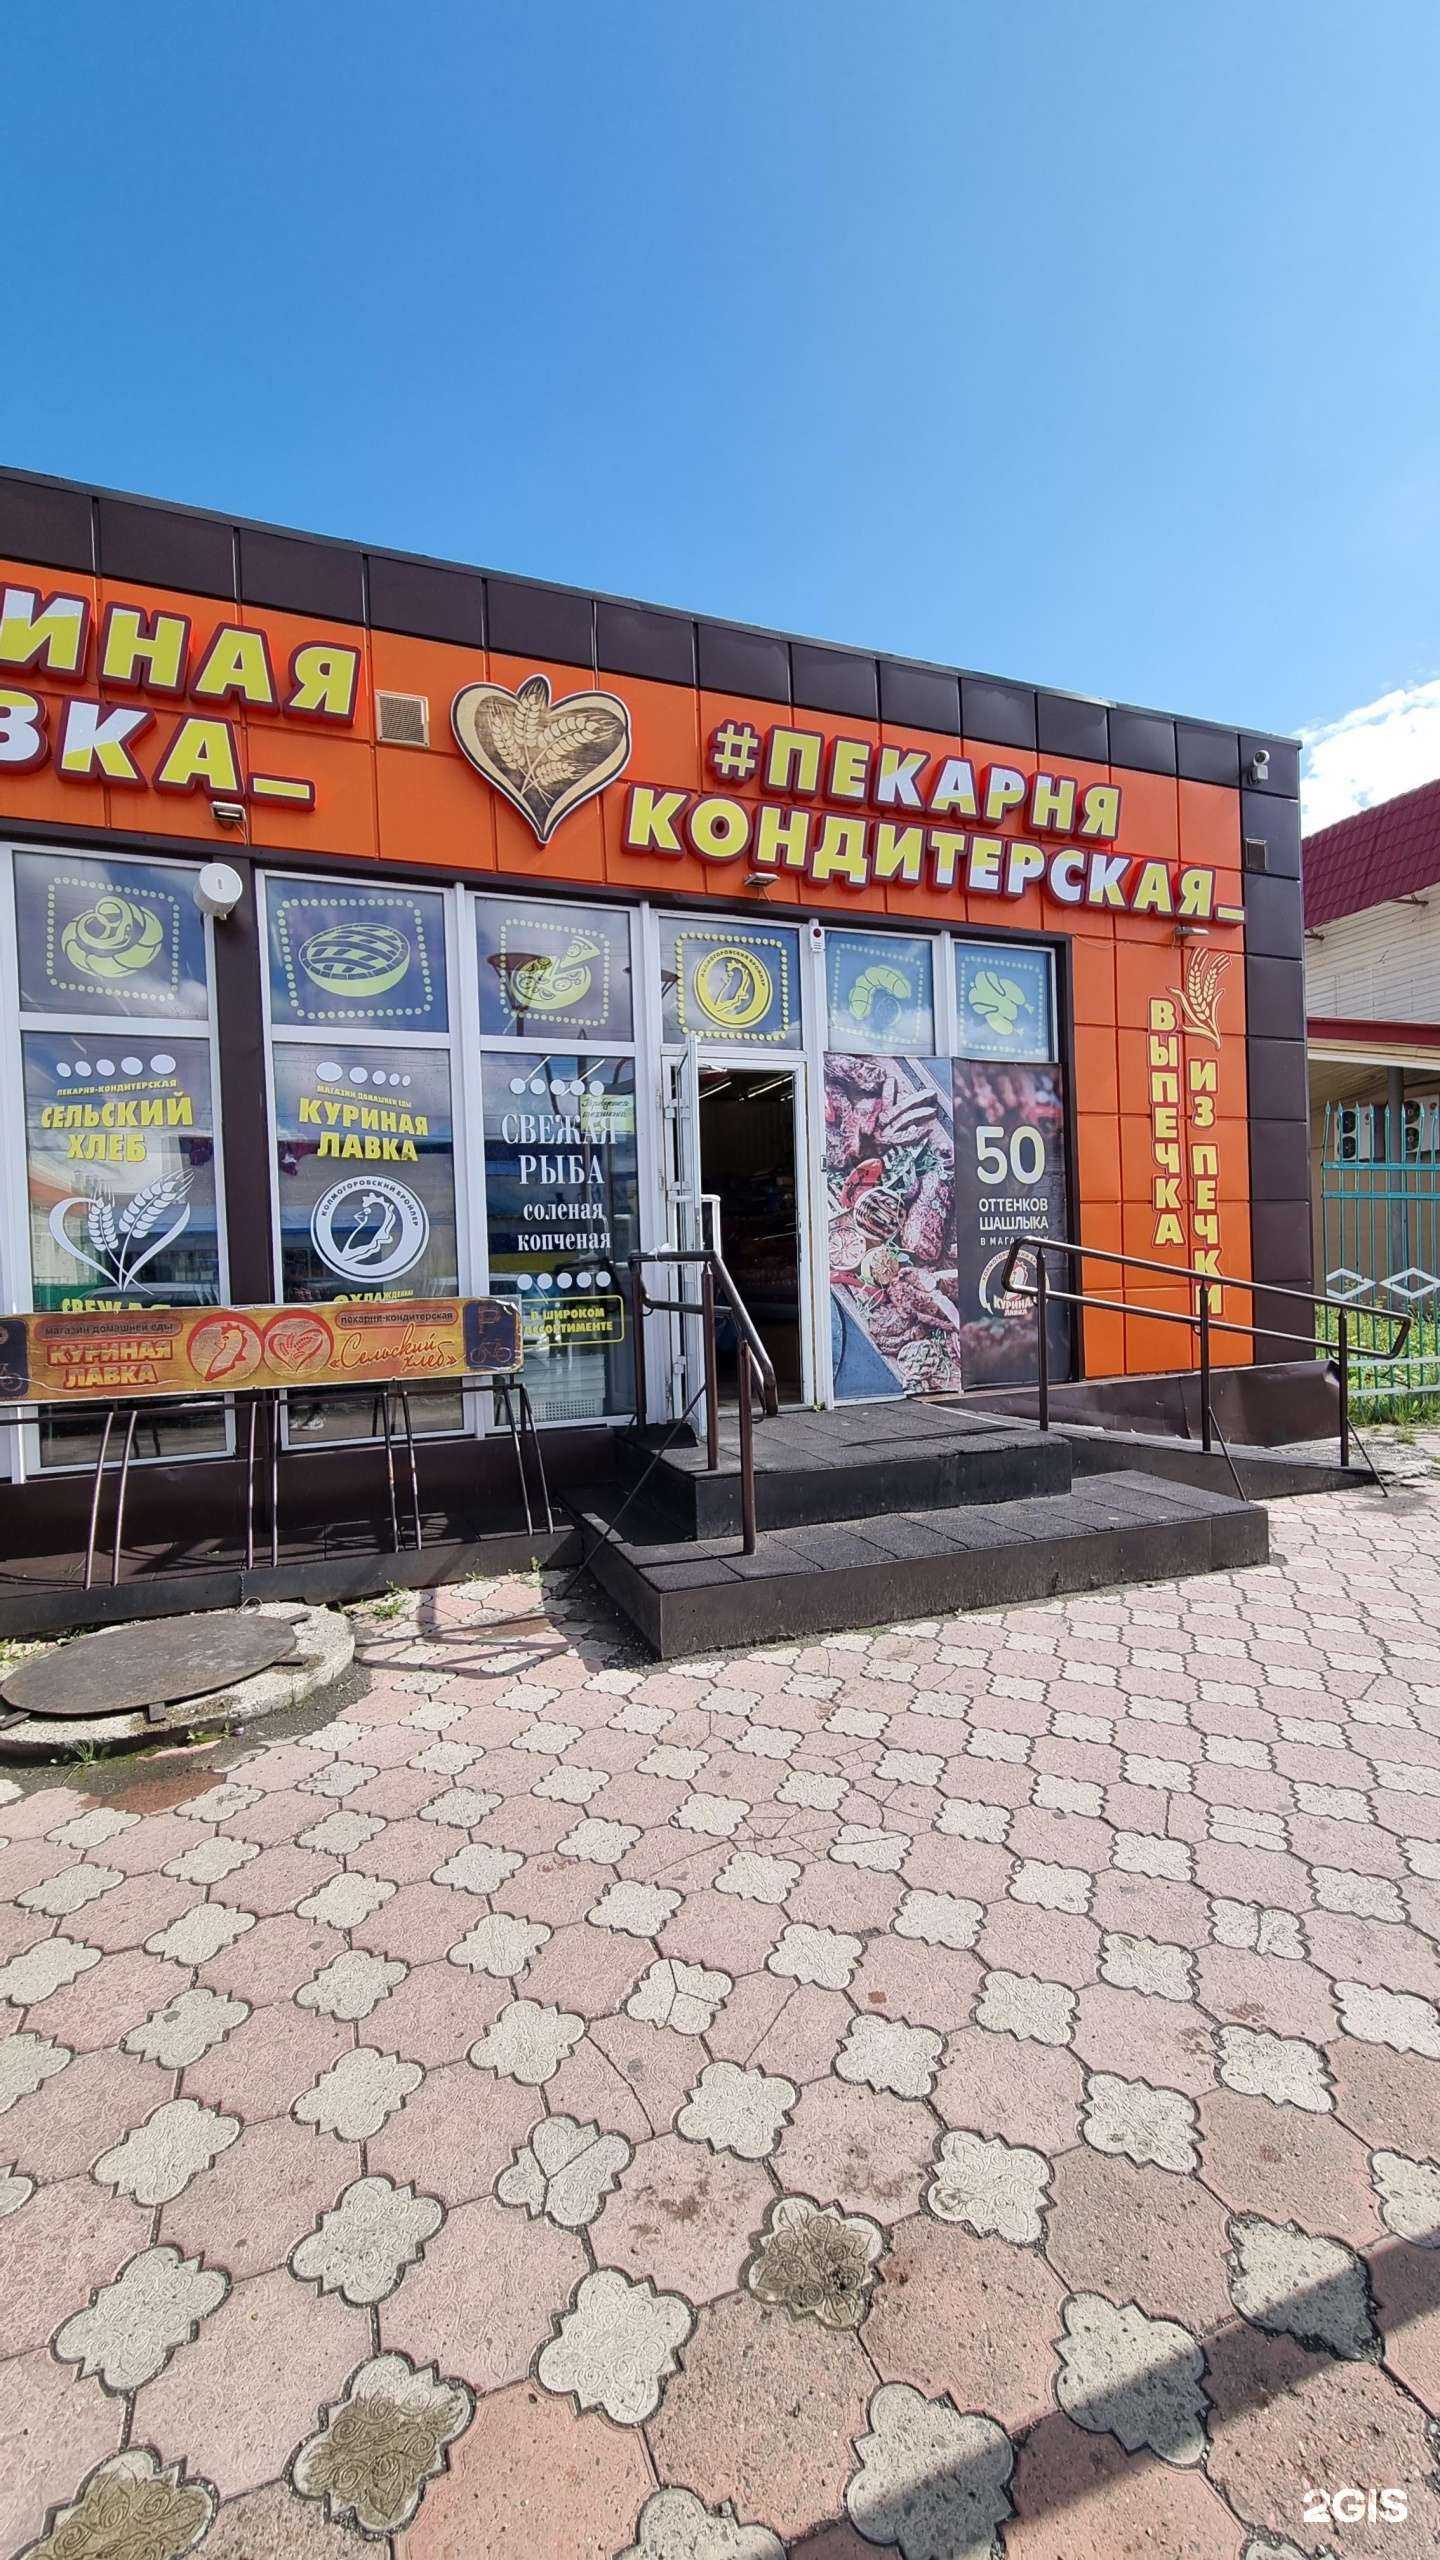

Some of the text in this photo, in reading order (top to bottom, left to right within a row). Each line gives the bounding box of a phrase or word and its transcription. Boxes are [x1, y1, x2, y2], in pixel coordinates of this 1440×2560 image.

[713, 723, 1119, 838] #ПЕКАРНЯ
[1189, 1060, 1217, 1126] ИЗ
[41, 1091, 193, 1129] СЕЛЬСКИЙ
[299, 1097, 429, 1136] КУРИНАЯ
[1150, 998, 1184, 1246] ВЫПЕЧКА
[502, 1113, 618, 1145] СВЕЖАЯ
[67, 1133, 147, 1162] ХЛЕБ
[317, 1131, 418, 1161] ЛАВКА
[976, 1126, 1046, 1184] 50
[518, 1155, 605, 1185] РЫБА
[523, 1202, 603, 1221] соленая
[979, 1198, 1048, 1212] ОТТЕНКОВ
[979, 1215, 1049, 1231] ШАШЛЫКА
[517, 1231, 612, 1251] копченая
[543, 1307, 605, 1320] ШИРОКОМ
[993, 1294, 1038, 1309] КУРИНА
[45, 1323, 91, 1335] магазин
[48, 1340, 173, 1365] КУРИНАЯ
[64, 1364, 158, 1389] ЛАВКА
